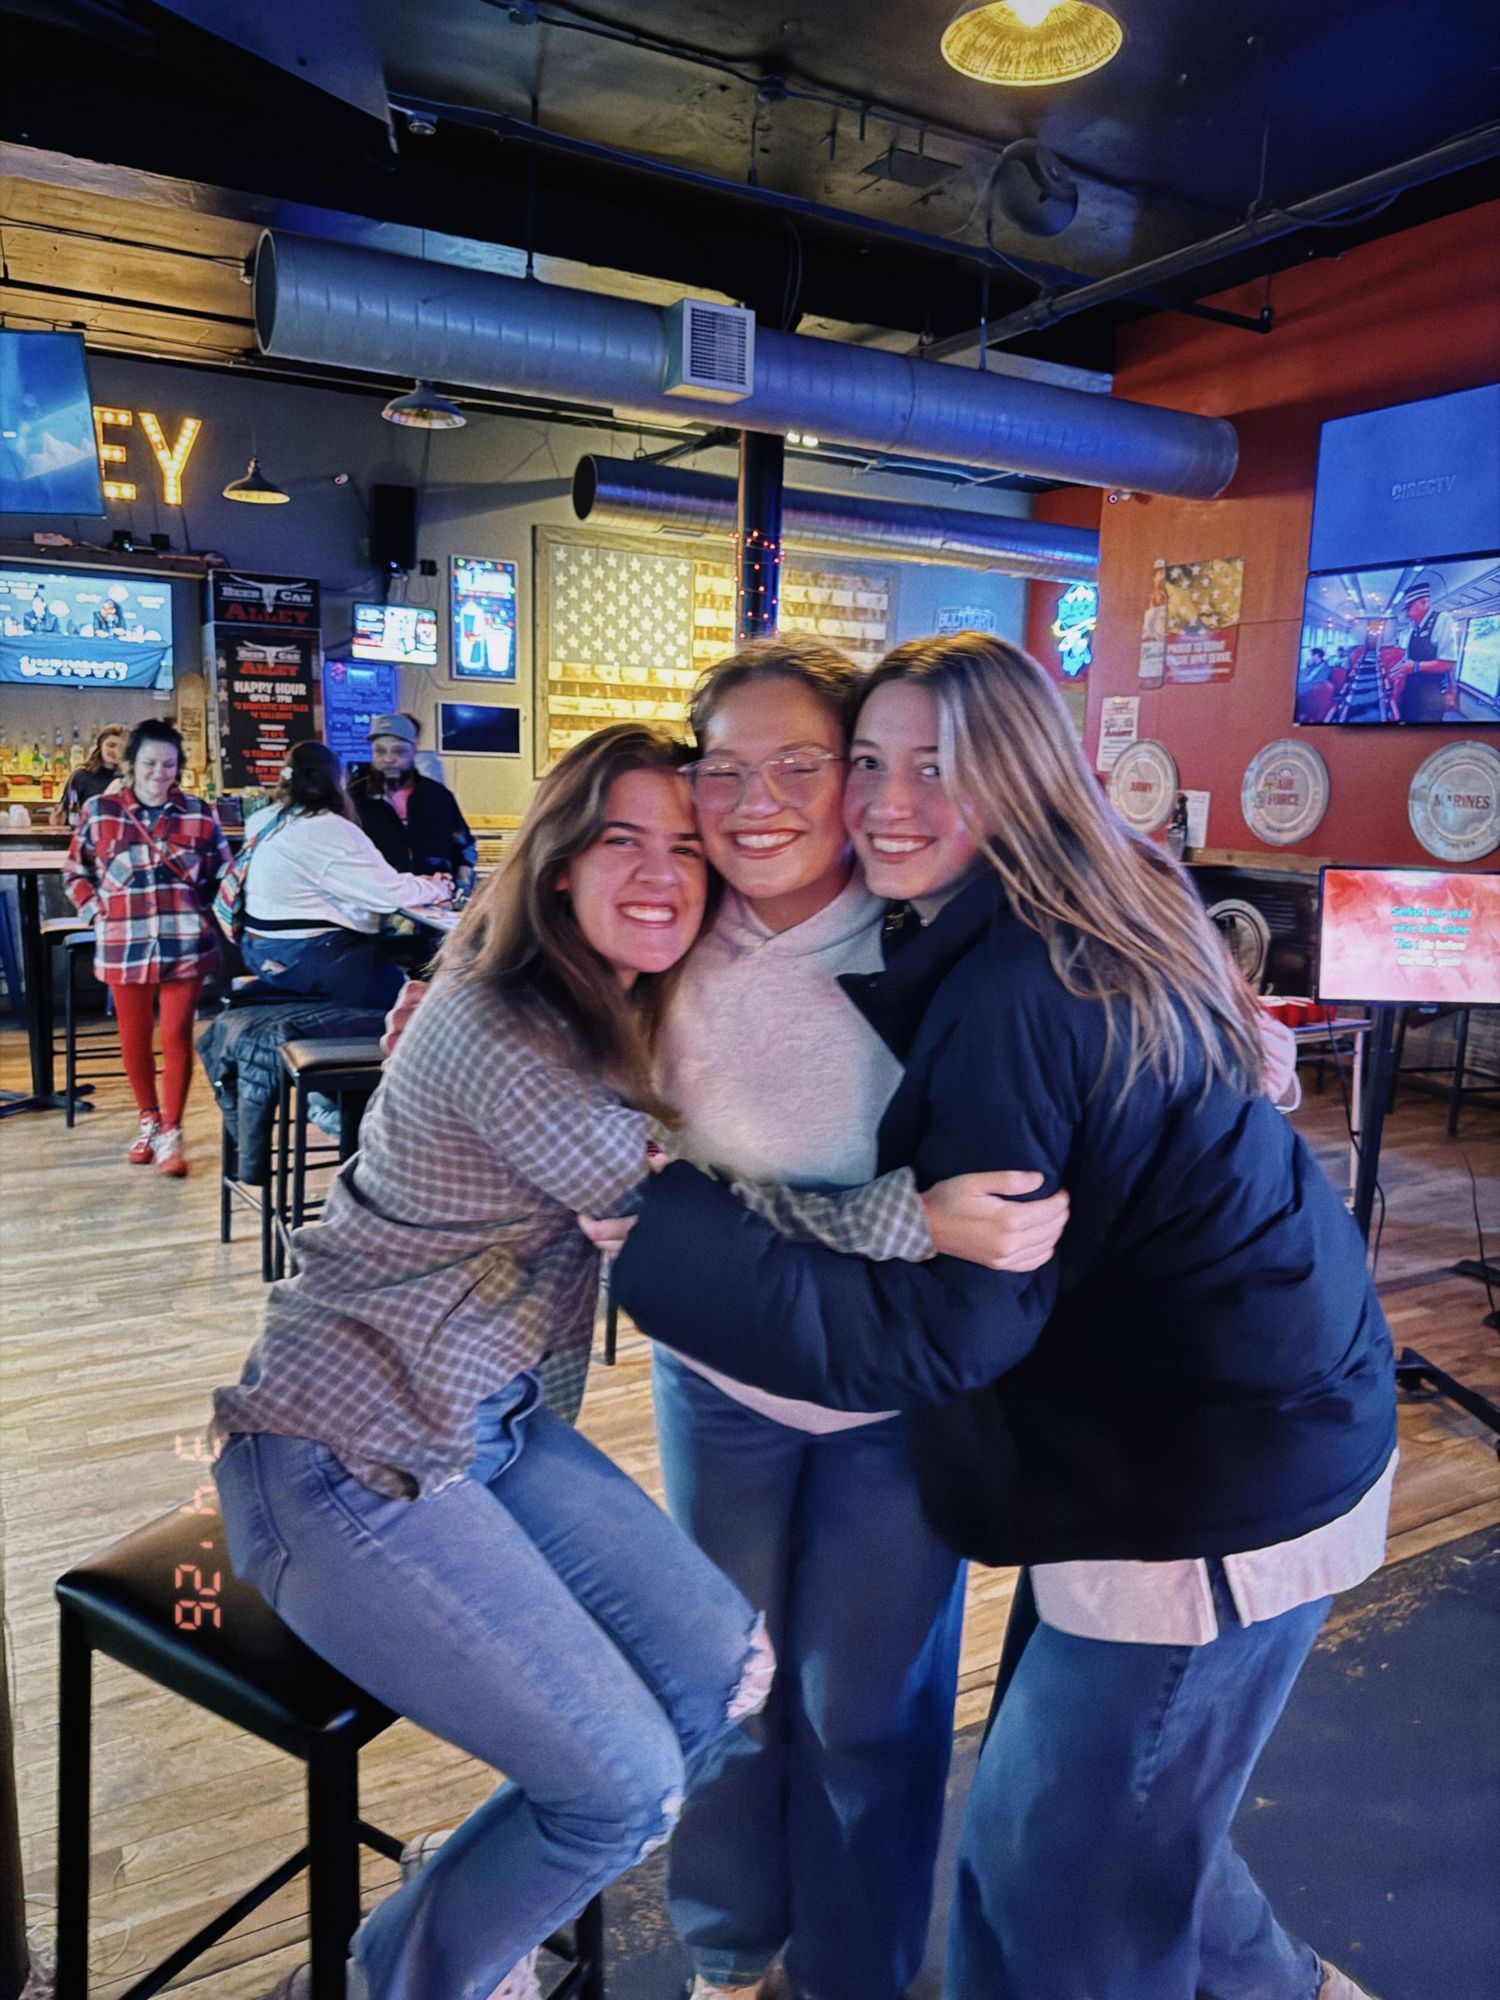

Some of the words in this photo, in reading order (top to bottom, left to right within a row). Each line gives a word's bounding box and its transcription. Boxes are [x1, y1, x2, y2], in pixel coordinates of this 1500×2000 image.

[1391, 474, 1456, 501] DIRECTV
[221, 586, 260, 599] BEER
[280, 591, 312, 603] CAN
[224, 603, 309, 625] ALLEY
[240, 661, 300, 676] ALLEY
[233, 680, 273, 694] HAPPY
[274, 682, 307, 696] HOUR
[249, 694, 270, 702] OPEN
[1129, 782, 1153, 792] ARMY
[1278, 777, 1295, 790] AIR
[1267, 793, 1300, 806] FORCE
[1391, 906, 1424, 916] Selfish
[1418, 923, 1440, 934] both
[1435, 940, 1467, 951] before
